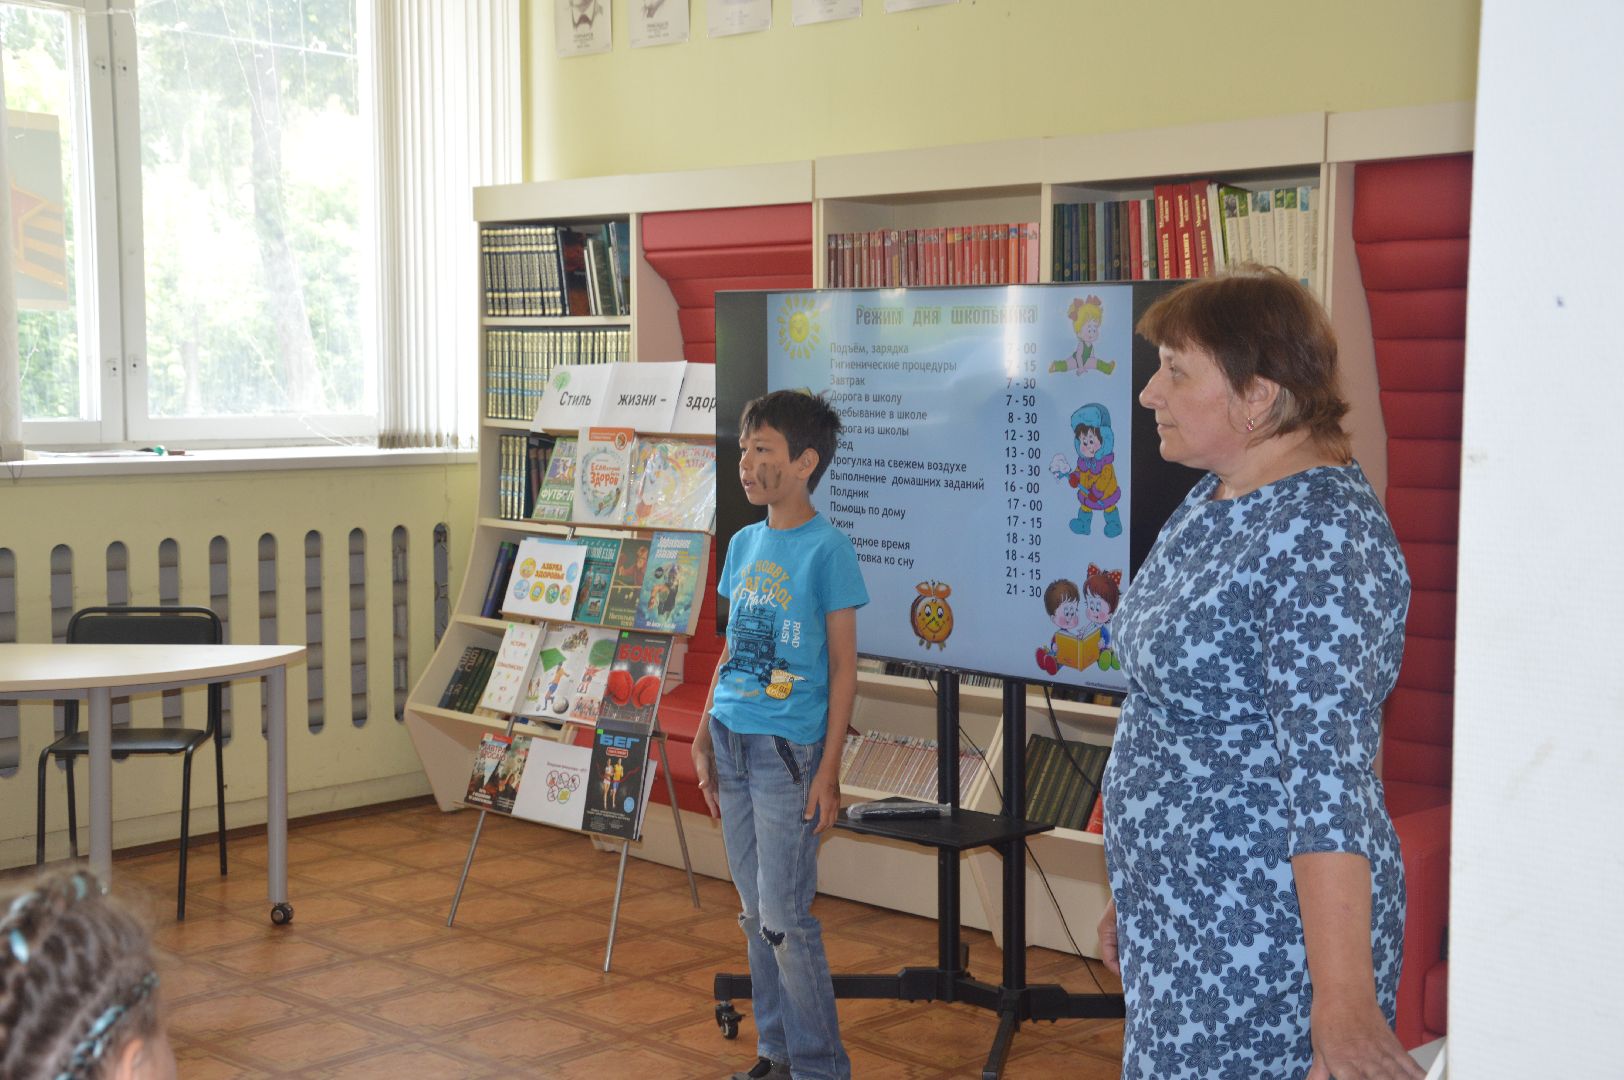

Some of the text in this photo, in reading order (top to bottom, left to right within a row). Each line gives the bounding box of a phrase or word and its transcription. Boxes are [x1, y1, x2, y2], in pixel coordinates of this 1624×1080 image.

[856, 306, 903, 325] Режим
[913, 307, 941, 326] дня
[830, 342, 909, 356] Подъём, зарядка
[1023, 342, 1037, 354] 00
[830, 359, 957, 373] Гигиенические процедуры
[1024, 360, 1037, 372] 15
[830, 375, 865, 387] Завтрак
[1006, 378, 1012, 389] 7
[1023, 378, 1036, 389] 30
[559, 391, 592, 406] Стиль
[616, 393, 658, 407] жизни
[685, 396, 717, 413] здор
[830, 390, 862, 404] Дорога
[872, 393, 902, 405] школу
[1006, 395, 1012, 406] 7
[1022, 395, 1035, 407] 50
[889, 411, 895, 419] в
[897, 410, 928, 420] школе
[1008, 412, 1014, 423] 8
[1025, 412, 1038, 424] 30
[840, 425, 909, 436] рога из школы
[1004, 429, 1017, 441] 12
[1027, 430, 1040, 441] 30
[837, 439, 854, 451] бед
[1005, 446, 1017, 458] 13
[1028, 447, 1041, 459] 00
[874, 459, 885, 467] на
[887, 459, 925, 470] свежем
[927, 461, 967, 475] воздухе
[1005, 464, 1017, 475] 13
[1028, 465, 1040, 476] 30
[830, 469, 985, 491] Выполнение домашних заданий
[830, 485, 869, 499] Полдник
[1004, 481, 1016, 492] 16
[1026, 482, 1040, 494] 00
[830, 501, 906, 519] Помощь по дому
[1007, 498, 1019, 509] 17
[1029, 499, 1043, 511] 00
[830, 517, 854, 529] Ужин
[1007, 515, 1019, 527] 17
[1030, 517, 1042, 529] 15
[848, 534, 910, 551] одное время
[1006, 532, 1018, 544] 18
[1028, 534, 1041, 546] 30
[857, 553, 915, 570] товка ко сну
[1005, 549, 1017, 561] 18
[1027, 552, 1041, 563] 45
[755, 559, 790, 583] HOBBY
[1006, 566, 1017, 578] 21
[1030, 568, 1041, 580] 15
[761, 577, 793, 611] COOL
[1006, 583, 1018, 595] 21
[1029, 586, 1042, 598] 30
[780, 618, 791, 645] DUST
[791, 621, 801, 649] ROAD
[618, 642, 665, 666] БОКС
[599, 734, 640, 748] БЕГ
